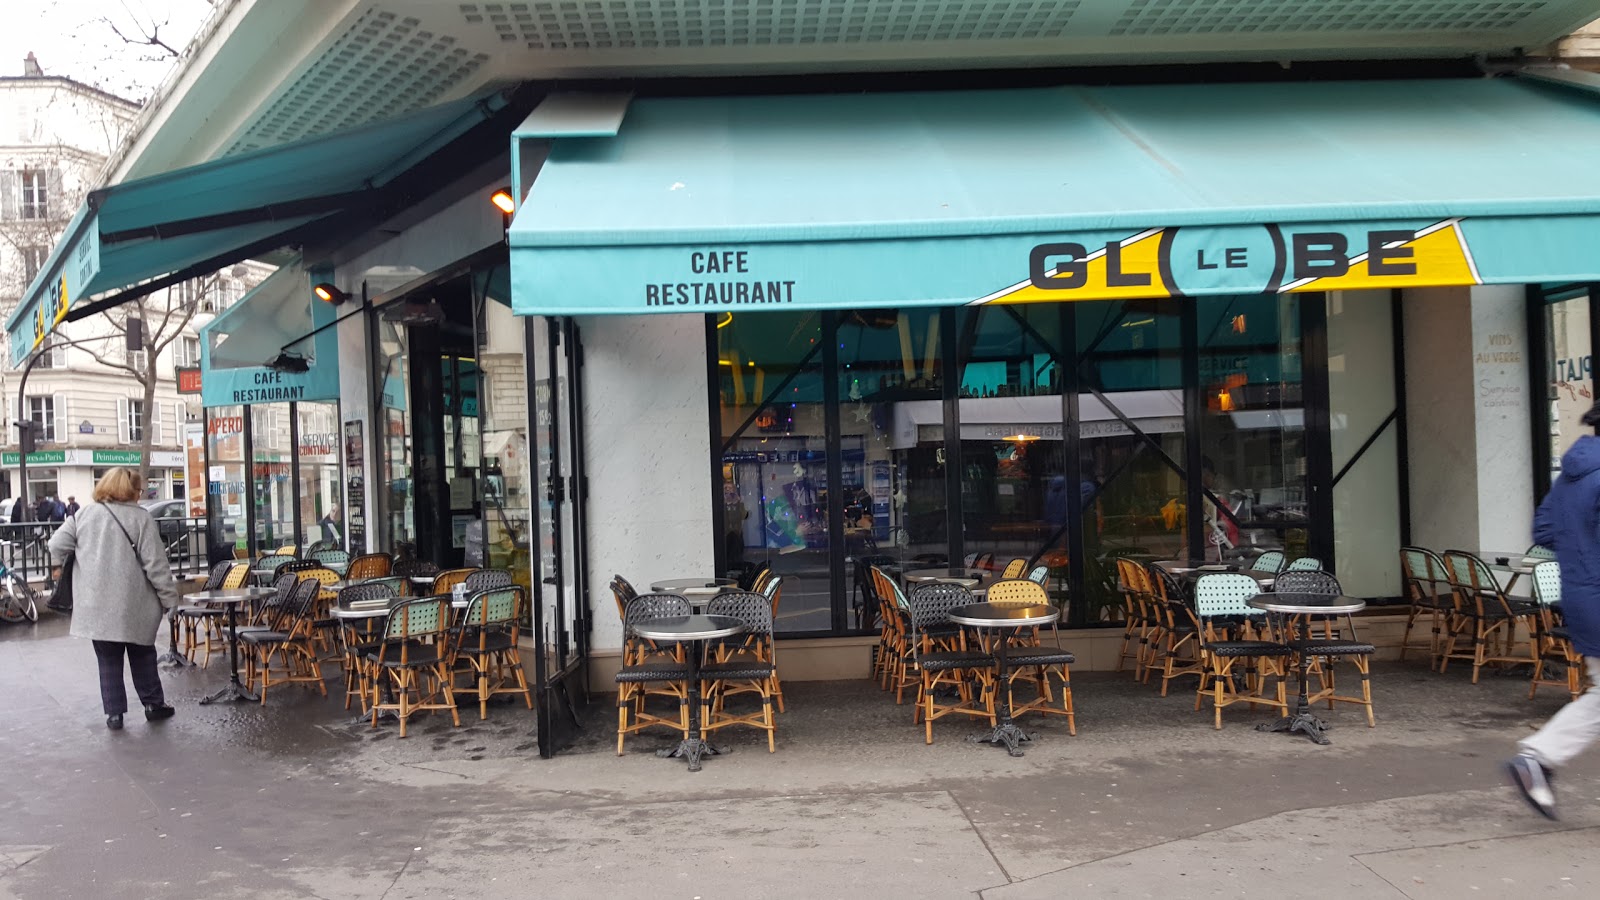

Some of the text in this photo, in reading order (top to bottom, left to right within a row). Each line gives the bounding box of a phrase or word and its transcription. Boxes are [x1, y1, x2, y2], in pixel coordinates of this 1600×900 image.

[692, 251, 748, 274] CAFE
[1197, 247, 1248, 270] LE
[646, 281, 796, 306] RESTAURANT
[254, 372, 282, 385] CAFE
[233, 386, 305, 402] RESTAURANT
[302, 432, 338, 449] SERVICE
[45, 452, 63, 461] Paris
[96, 452, 125, 461] Peintures
[209, 481, 246, 495] COCKTAILS
